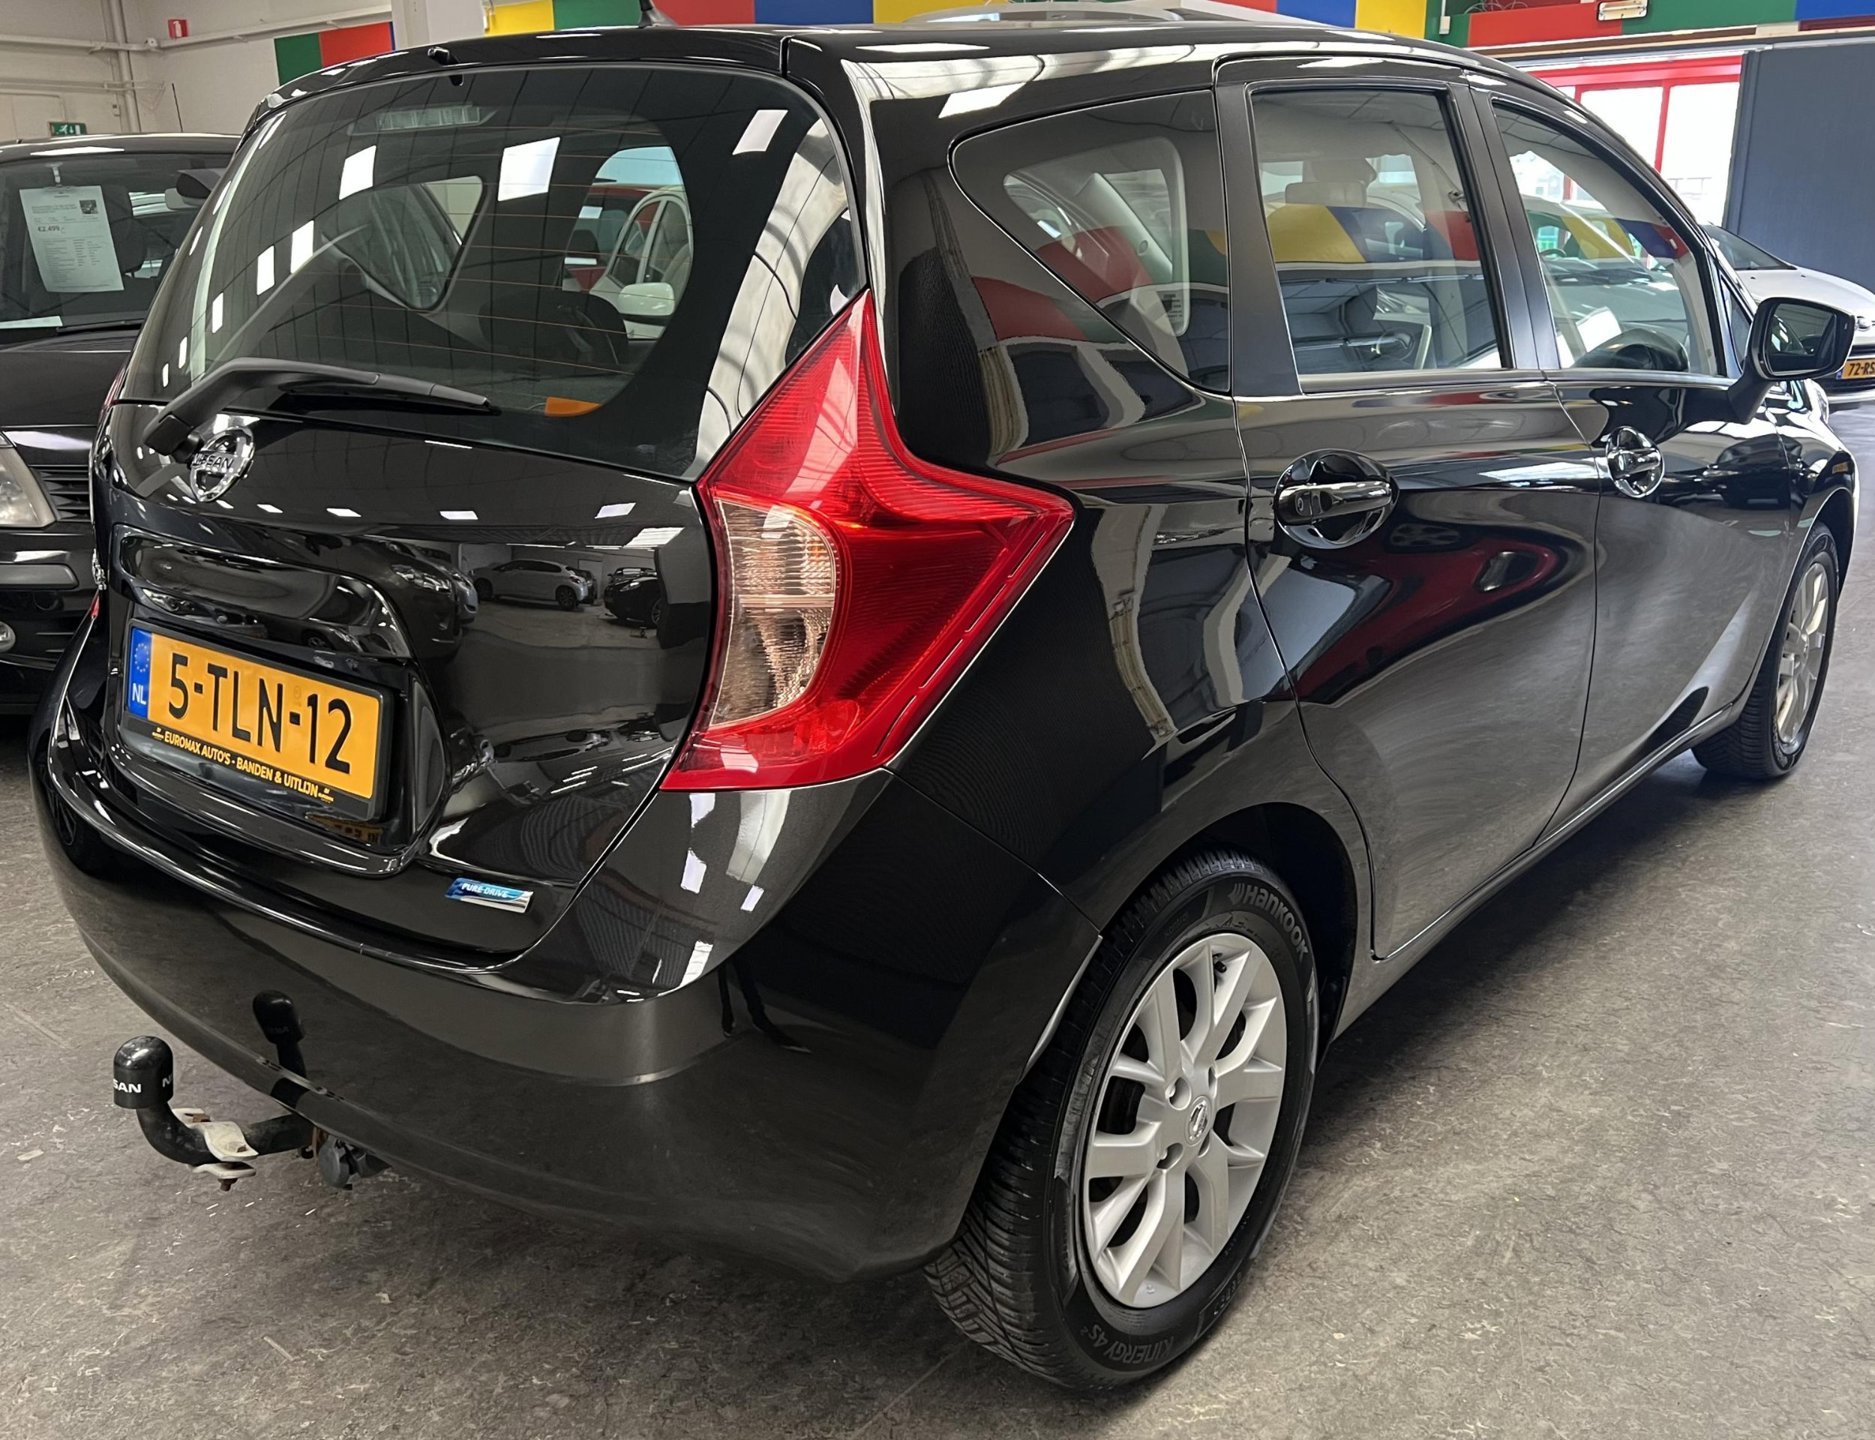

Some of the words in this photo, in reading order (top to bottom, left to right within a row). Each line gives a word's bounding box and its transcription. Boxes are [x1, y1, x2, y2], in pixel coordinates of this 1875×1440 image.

[132, 682, 147, 705] NL
[168, 652, 351, 775] 5-TLN-12
[164, 731, 201, 754] EUROMAX
[201, 745, 231, 765] AUTO'S
[236, 757, 273, 781] BANDEN
[274, 772, 282, 783] &
[461, 883, 483, 894] PURE
[483, 887, 508, 898] DRIVE
